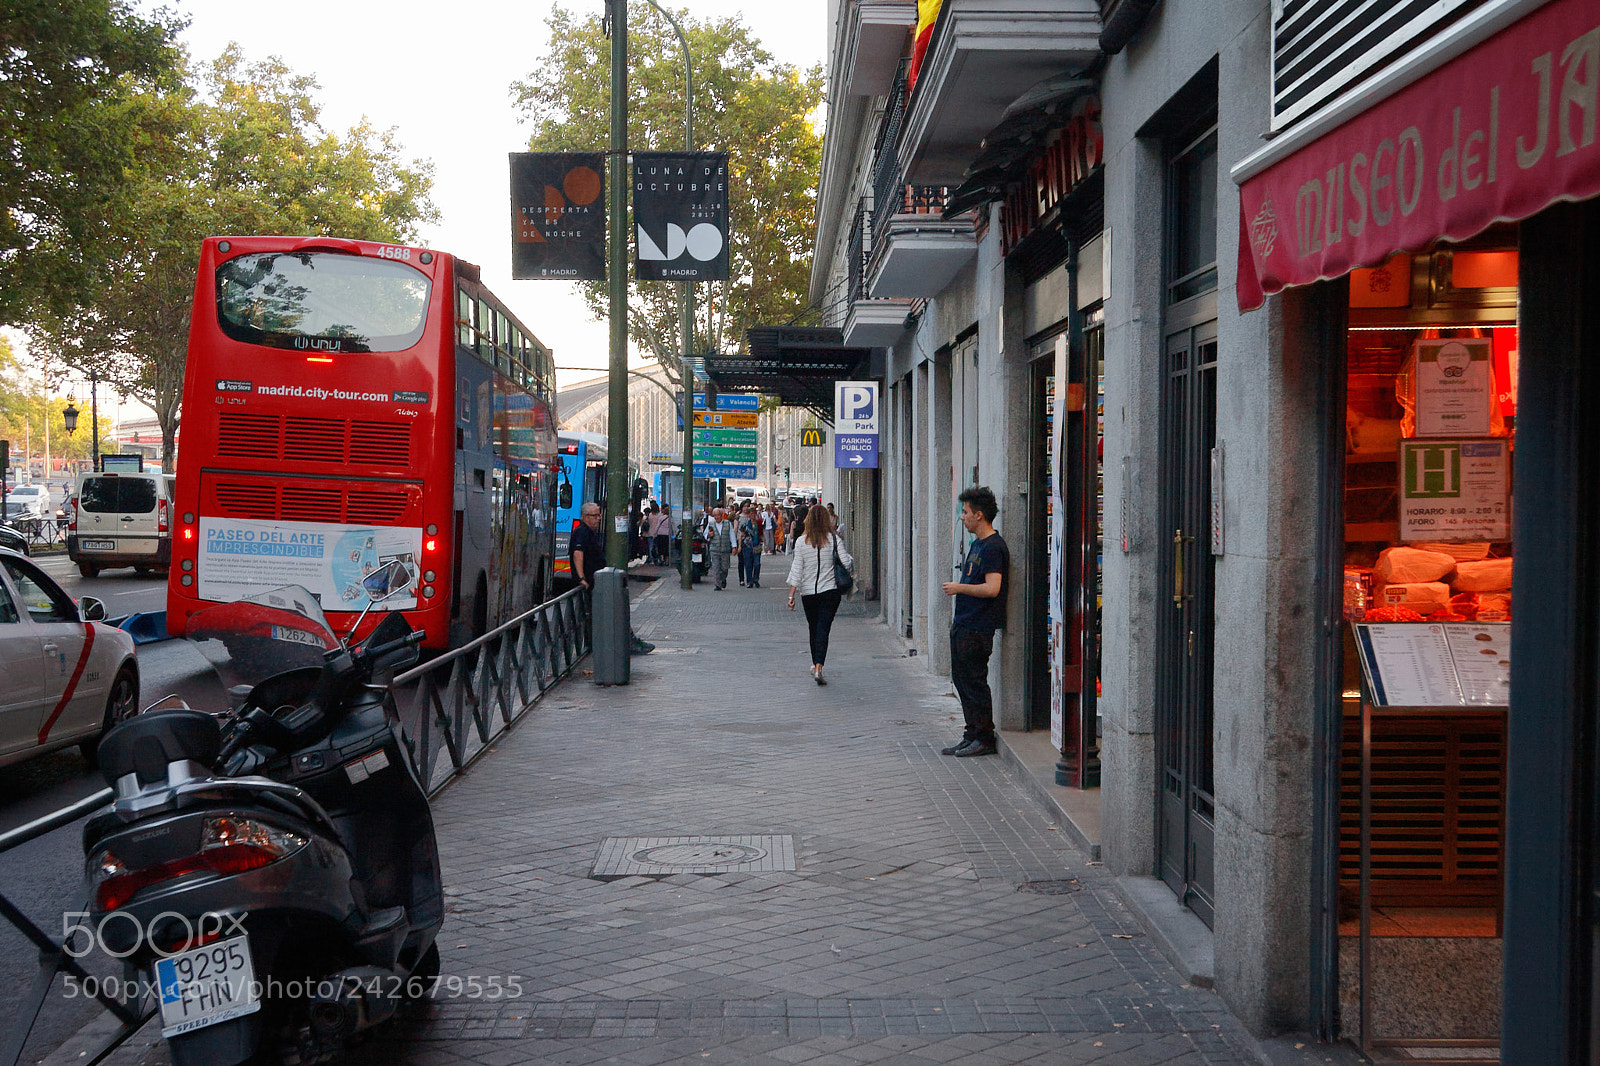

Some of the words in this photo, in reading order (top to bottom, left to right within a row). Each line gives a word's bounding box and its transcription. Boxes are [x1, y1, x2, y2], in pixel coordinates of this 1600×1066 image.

[1438, 87, 1500, 202] del
[637, 166, 685, 176] LUNA
[704, 166, 724, 176] DE
[637, 182, 724, 192] OCTUBRE
[521, 206, 589, 214] DESPIERTA
[545, 218, 558, 226] ES
[522, 230, 535, 238] DE
[545, 230, 582, 238] NOCHE
[377, 244, 411, 261] 4588
[550, 268, 577, 276] MADRID
[670, 268, 698, 276] MADRID
[257, 384, 389, 403] madrid.city-tour.com
[844, 387, 871, 419] P
[841, 443, 872, 451] PÚBLICO
[1410, 447, 1458, 494] H
[207, 528, 255, 542] PASEO
[260, 531, 285, 543] DEL
[289, 533, 325, 545] ARTE
[207, 540, 323, 558] IMPRESCINDIBLE
[280, 627, 306, 643] 1262
[177, 943, 245, 984] 9295
[180, 975, 232, 1016] FHN
[176, 1017, 209, 1033] SPEED
